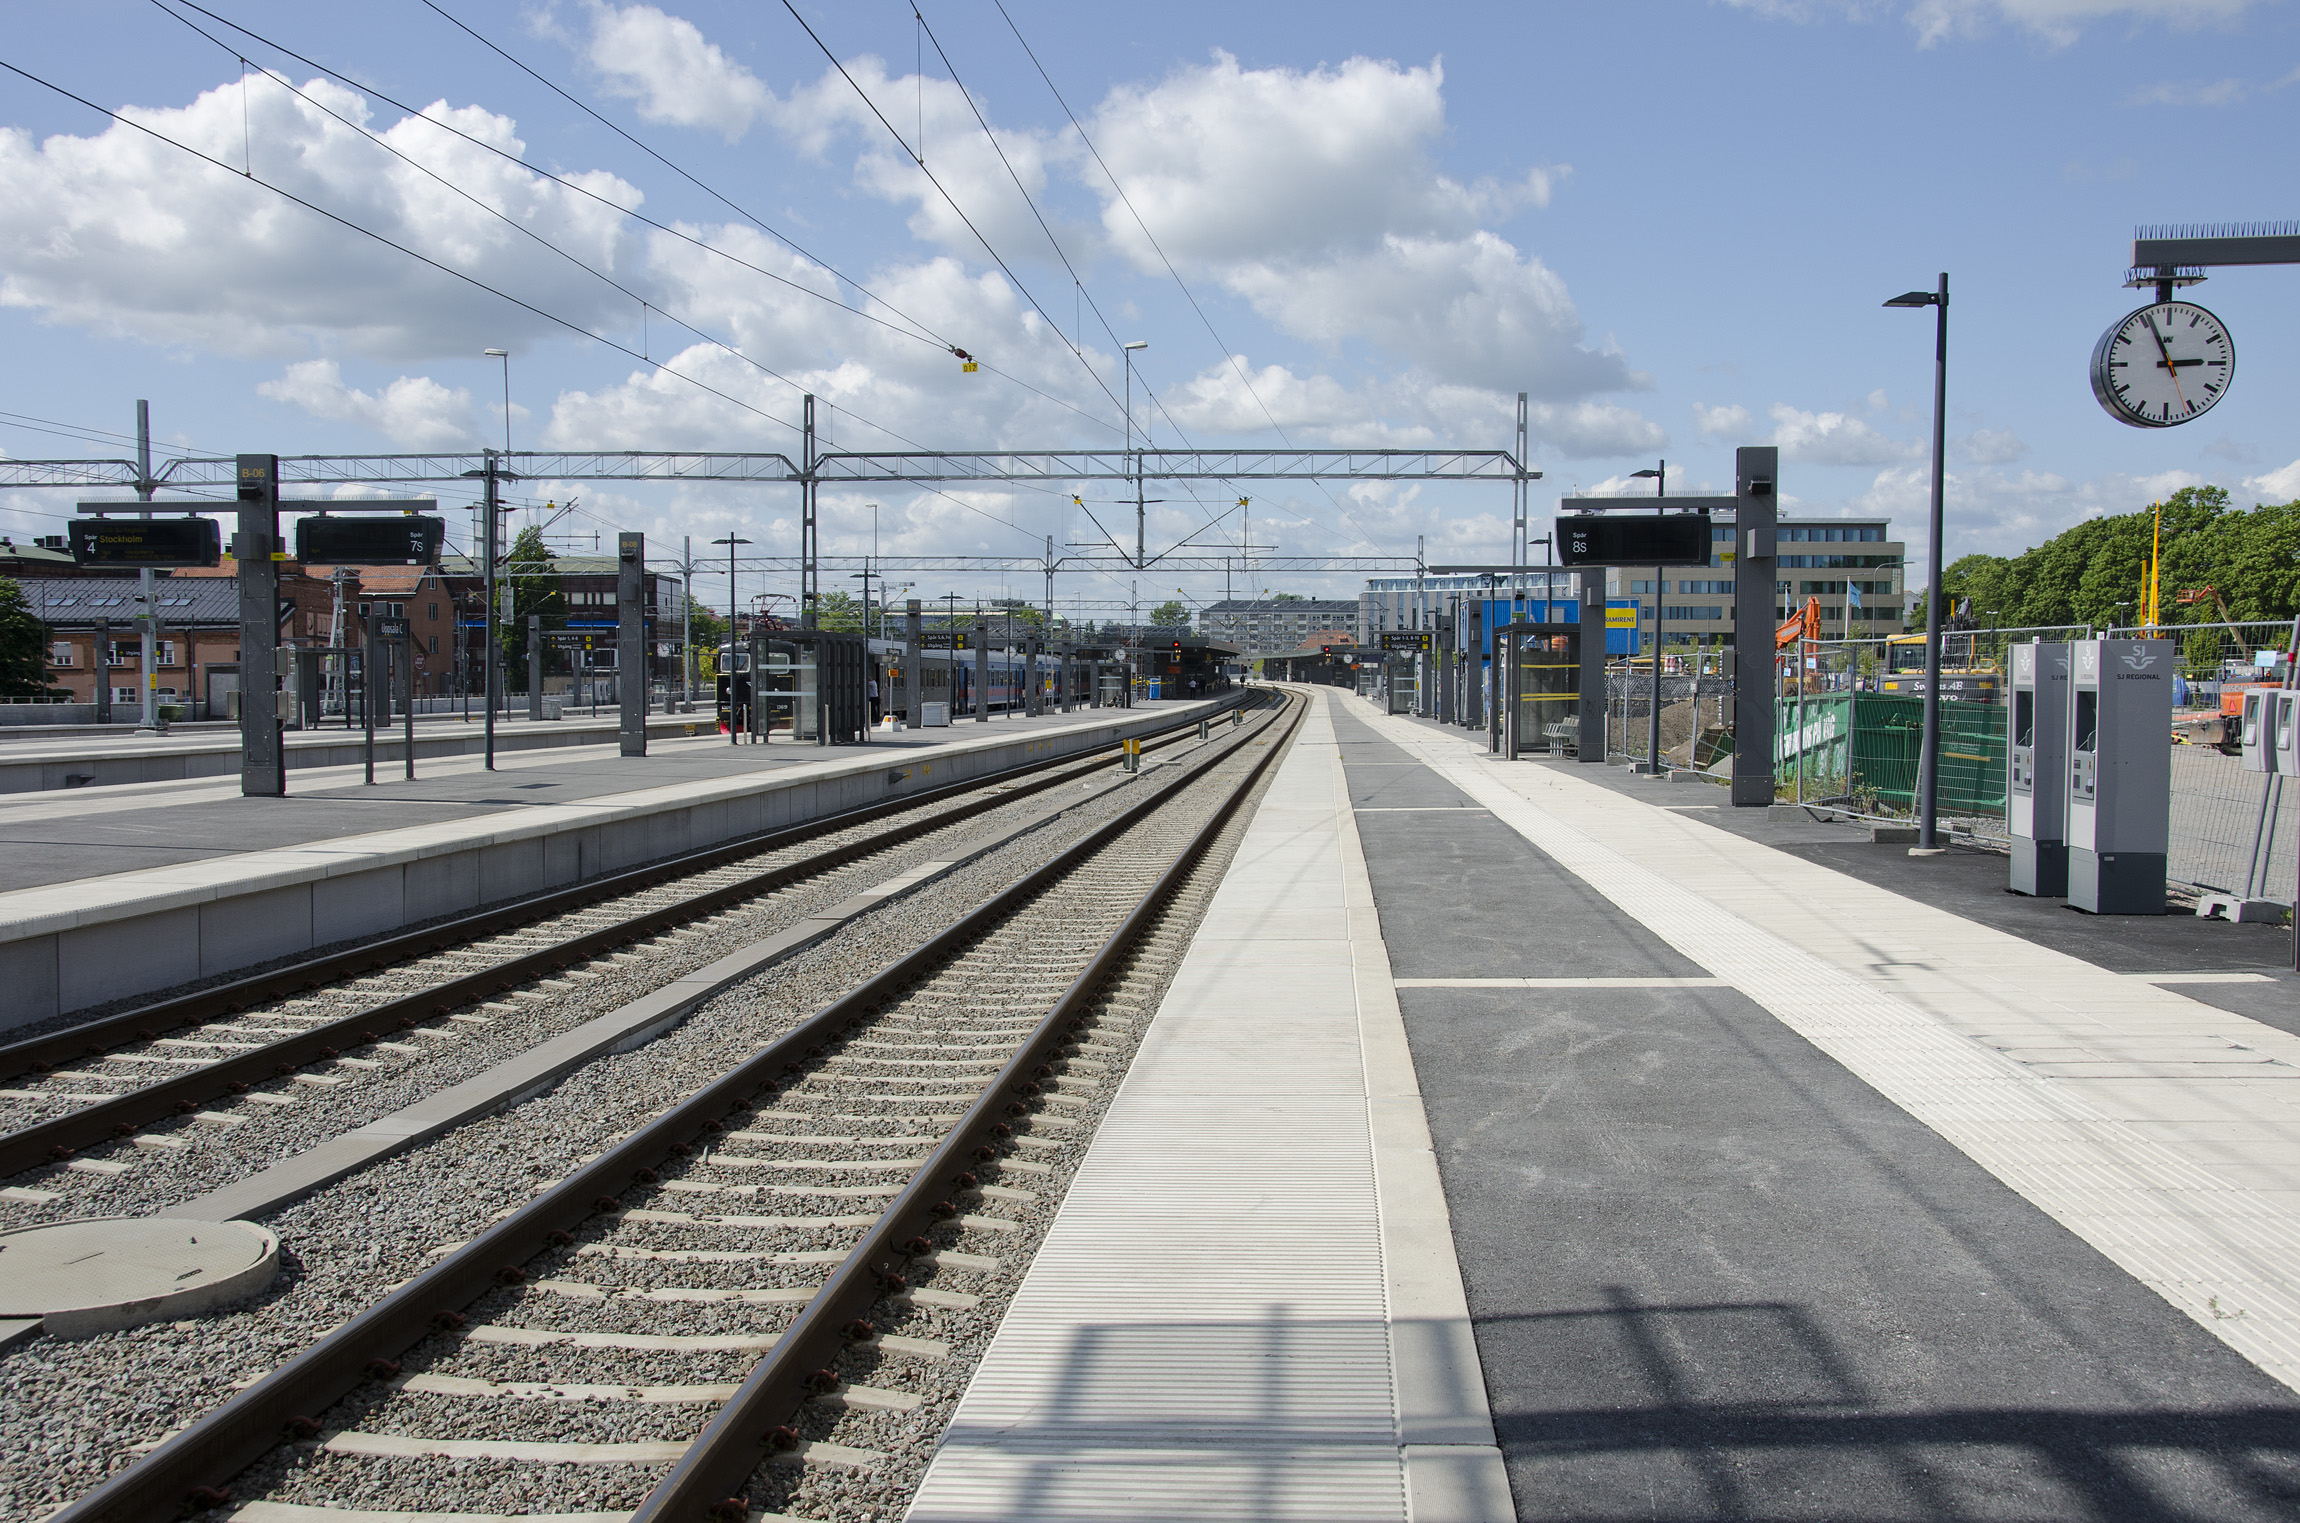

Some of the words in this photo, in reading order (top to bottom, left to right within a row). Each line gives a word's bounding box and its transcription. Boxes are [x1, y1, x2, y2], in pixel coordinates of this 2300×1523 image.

[242, 468, 264, 478] B-06
[100, 535, 142, 543] Stockholm
[87, 542, 96, 554] 4
[410, 540, 423, 552] 7S
[1573, 540, 1587, 552] 8S
[381, 622, 399, 636] Uppsala
[399, 624, 403, 634] C
[2132, 645, 2146, 657] SJ
[1947, 681, 1964, 690] AB
